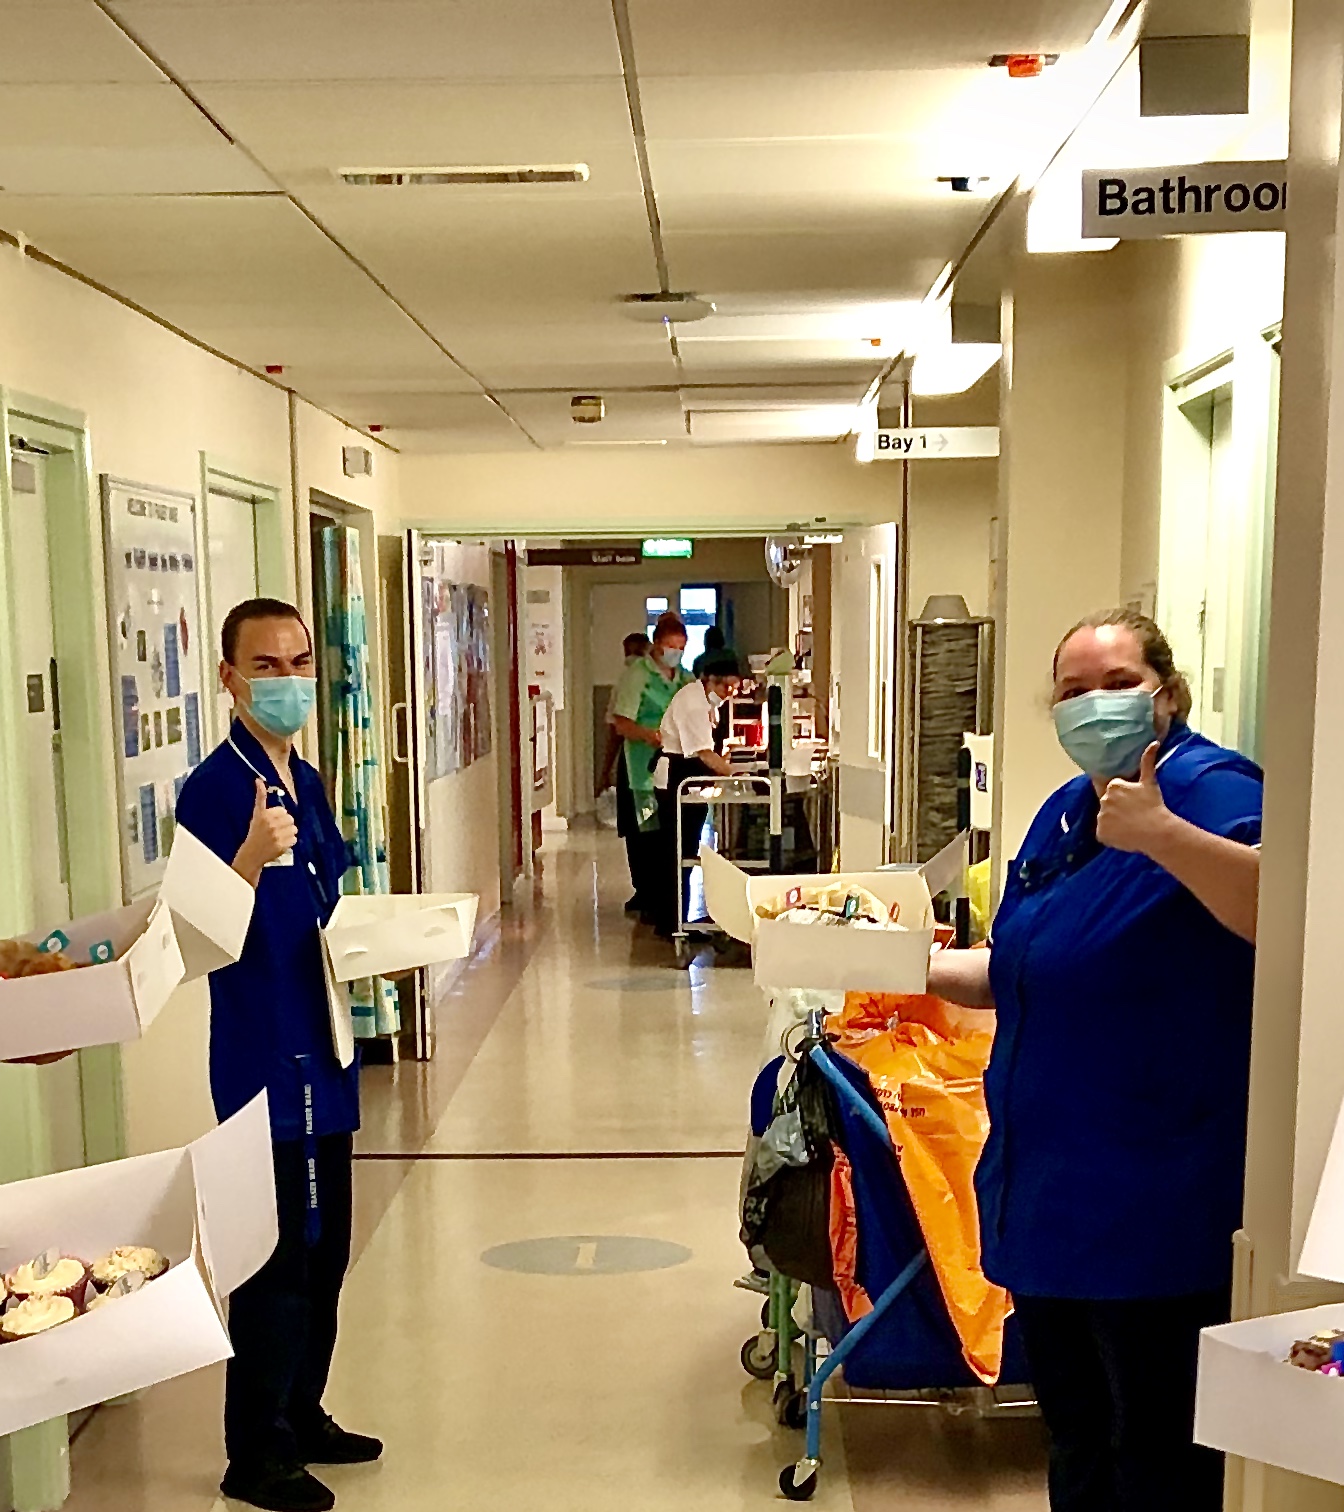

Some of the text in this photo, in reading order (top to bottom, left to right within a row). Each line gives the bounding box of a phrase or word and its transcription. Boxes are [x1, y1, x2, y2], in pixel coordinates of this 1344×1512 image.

[1098, 176, 1287, 215] Bathroo
[877, 433, 927, 453] Bay 1
